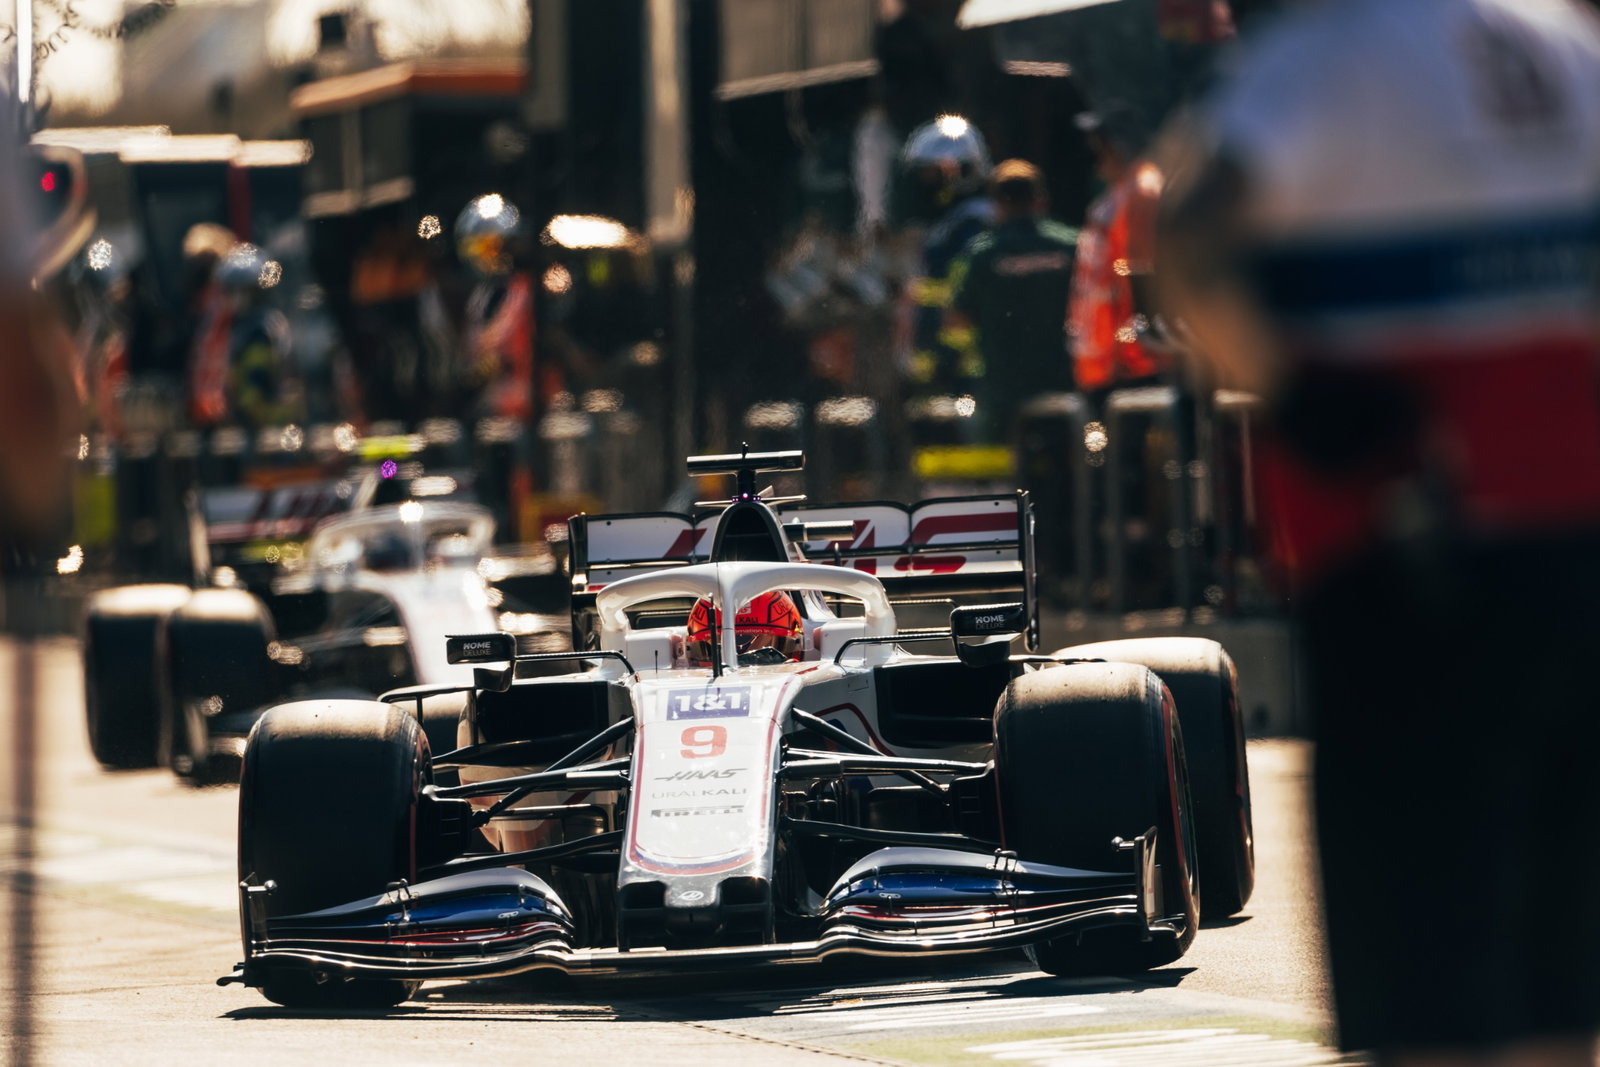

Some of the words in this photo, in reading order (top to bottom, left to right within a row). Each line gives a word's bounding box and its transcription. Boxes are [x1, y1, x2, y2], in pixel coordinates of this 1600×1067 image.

[975, 614, 1005, 624] HOME
[463, 641, 492, 650] HOME
[463, 649, 492, 657] DELUXE
[675, 692, 742, 712] 1&1
[680, 725, 728, 759] 9
[653, 768, 749, 781] HAAS
[652, 788, 748, 800] URALKALI
